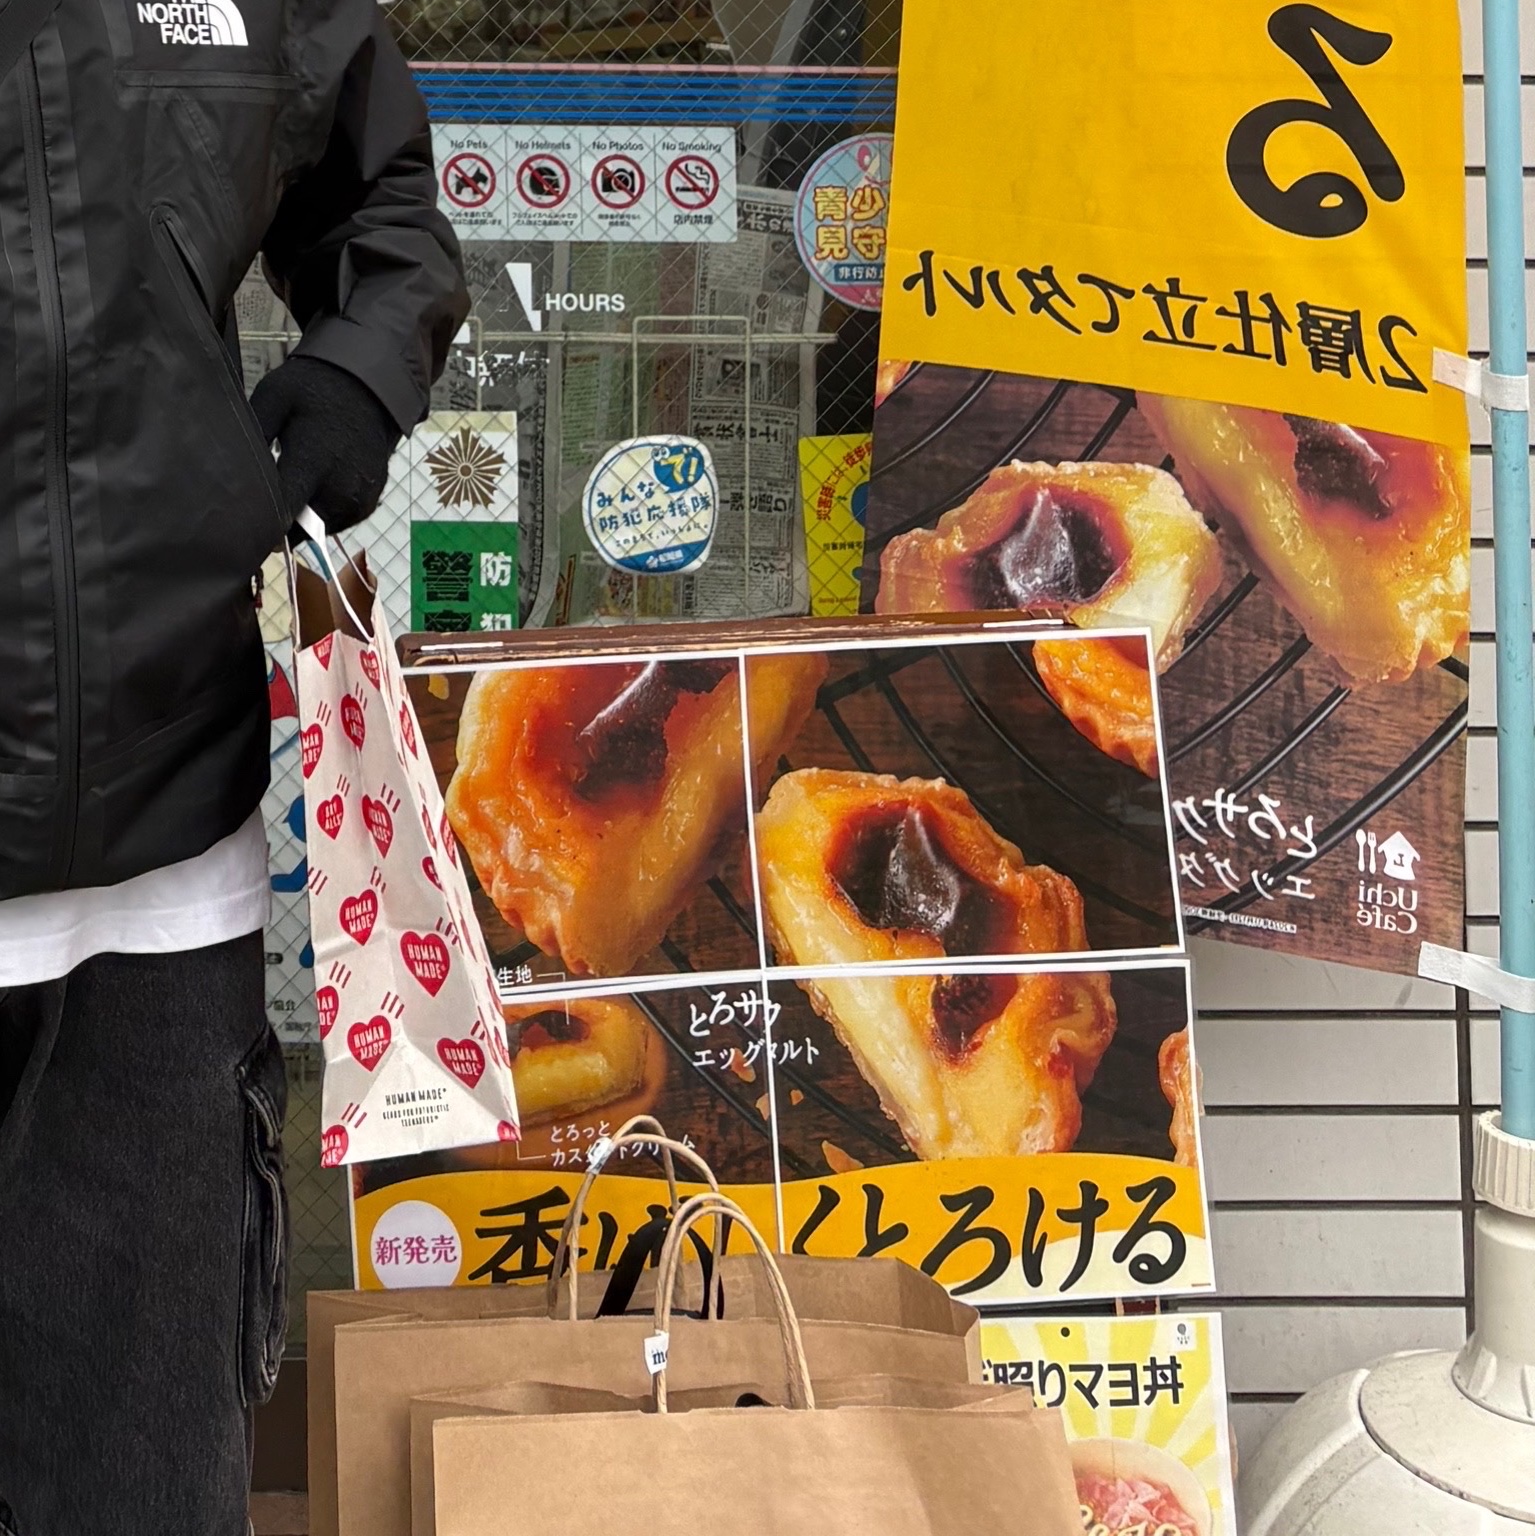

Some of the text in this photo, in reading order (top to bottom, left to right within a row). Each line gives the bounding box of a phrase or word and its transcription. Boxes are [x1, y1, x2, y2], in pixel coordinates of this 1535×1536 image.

[137, 2, 208, 25] NORTH
[161, 24, 211, 45] FACE
[451, 140, 488, 150] No Pets
[516, 141, 571, 151] No Helmets
[593, 141, 644, 153] No Photos
[663, 142, 722, 154] No Smoking
[838, 266, 885, 280] 非行防
[545, 293, 625, 311] HOURS
[597, 481, 655, 508] みんな
[599, 492, 711, 532] 防犯応援隊
[345, 897, 374, 920] HUMAN
[348, 914, 374, 934] MADE
[408, 944, 443, 961] HUMAN
[414, 960, 446, 980] MADE
[498, 965, 533, 985] 生地
[690, 990, 782, 1037] とろサク
[354, 1025, 384, 1048] HUMAN
[444, 1046, 478, 1062] HUMAN
[452, 1059, 481, 1076] MADE
[385, 1088, 445, 1106] HUMAN MADE
[551, 1121, 611, 1143] とろっと
[375, 1235, 458, 1267] 新発売
